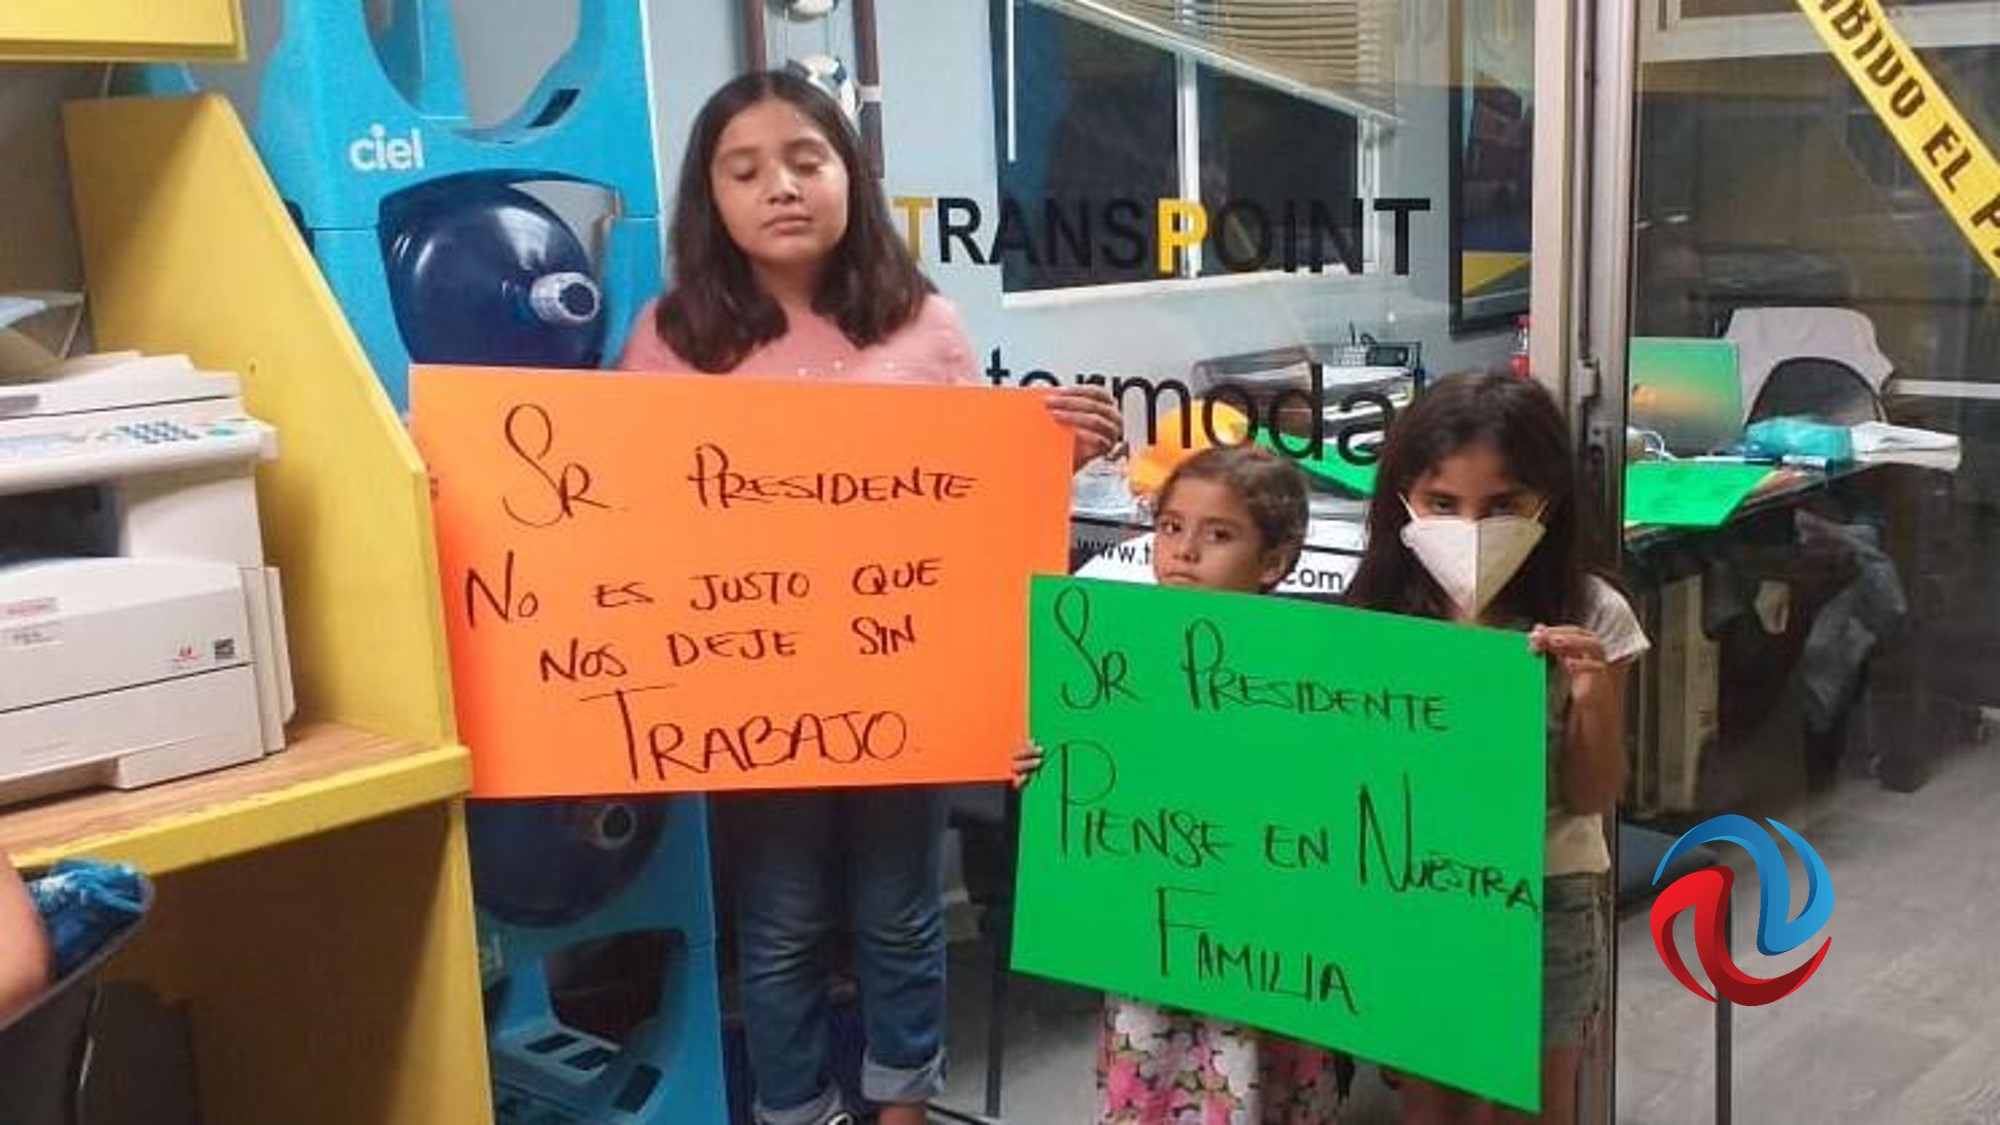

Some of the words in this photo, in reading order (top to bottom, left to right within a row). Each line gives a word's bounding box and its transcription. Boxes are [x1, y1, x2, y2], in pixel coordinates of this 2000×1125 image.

[349, 123, 425, 171] ciel
[1921, 120, 1973, 195] EL
[1969, 193, 2000, 259] P
[893, 197, 1430, 277] TRANSPOINT
[688, 444, 979, 509] PRESIDENTE
[595, 579, 654, 609] ES
[689, 571, 811, 612] JUSTO
[851, 557, 943, 597] QUE
[540, 637, 628, 684] NOS
[666, 630, 798, 668] DEJE
[851, 614, 917, 657] SIN
[1180, 618, 1449, 732] PRESIDENTE
[1040, 738, 1233, 869] PIENSE
[1264, 823, 1330, 869] EN
[1358, 771, 1540, 920] NUESTRA
[1156, 886, 1360, 1017] FAMILIA
